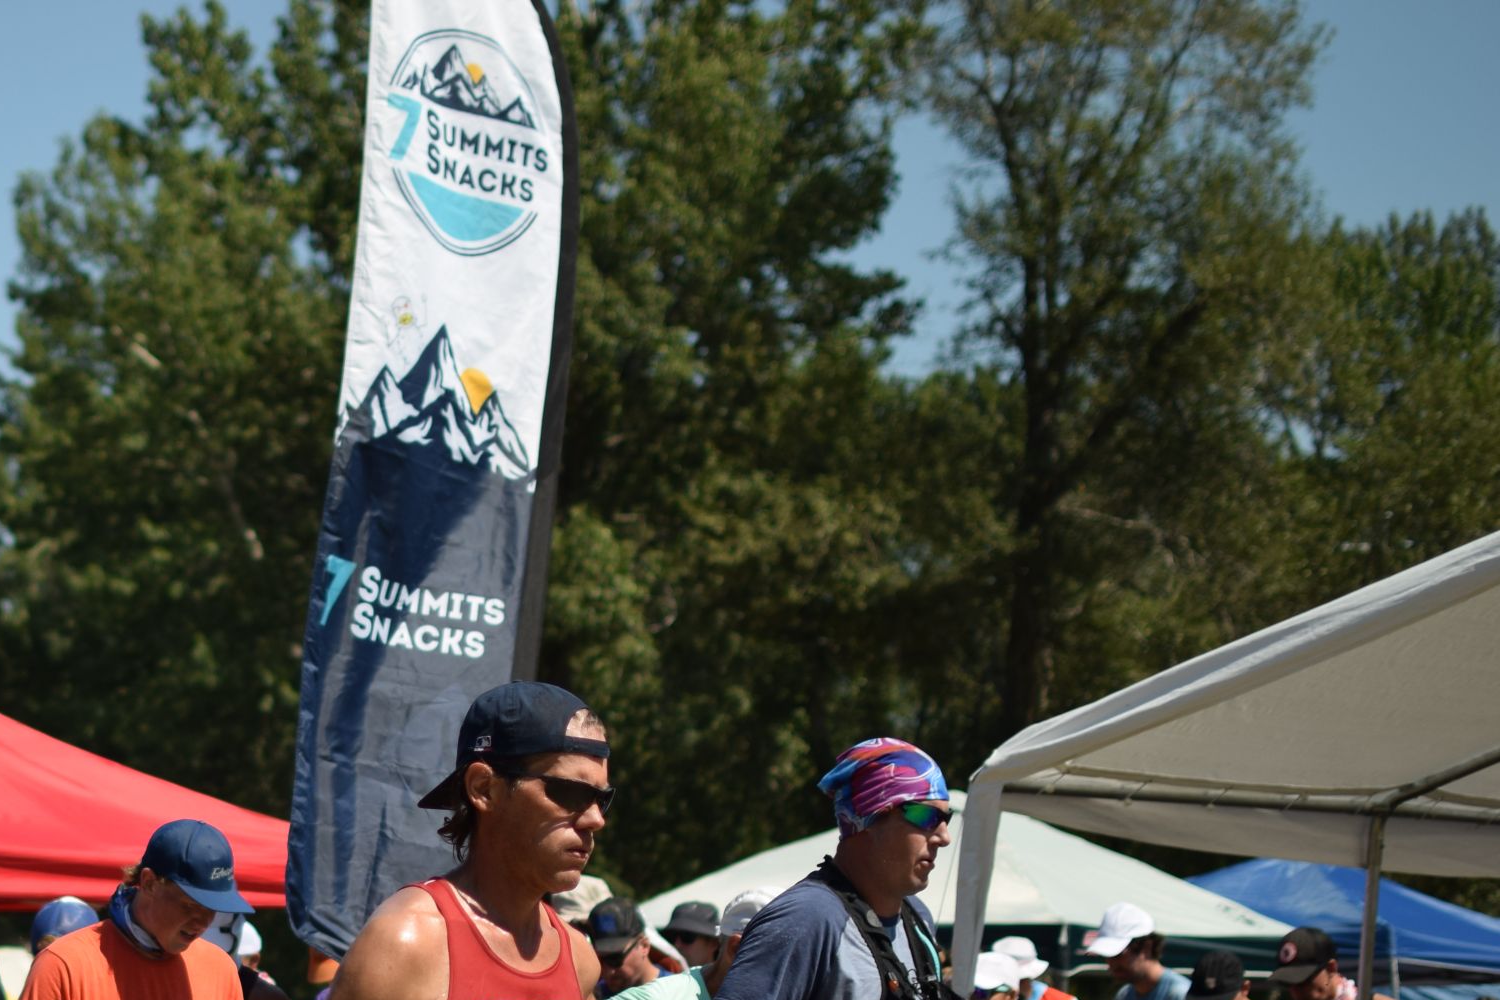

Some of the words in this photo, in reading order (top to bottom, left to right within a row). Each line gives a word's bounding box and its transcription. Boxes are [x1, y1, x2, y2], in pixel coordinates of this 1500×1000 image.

[387, 93, 422, 160] 7
[427, 109, 548, 172] SUMMITS
[427, 143, 534, 202] SNACKS
[320, 554, 357, 626] 7
[358, 566, 506, 626] SUMMITS
[350, 602, 486, 658] SNACKS
